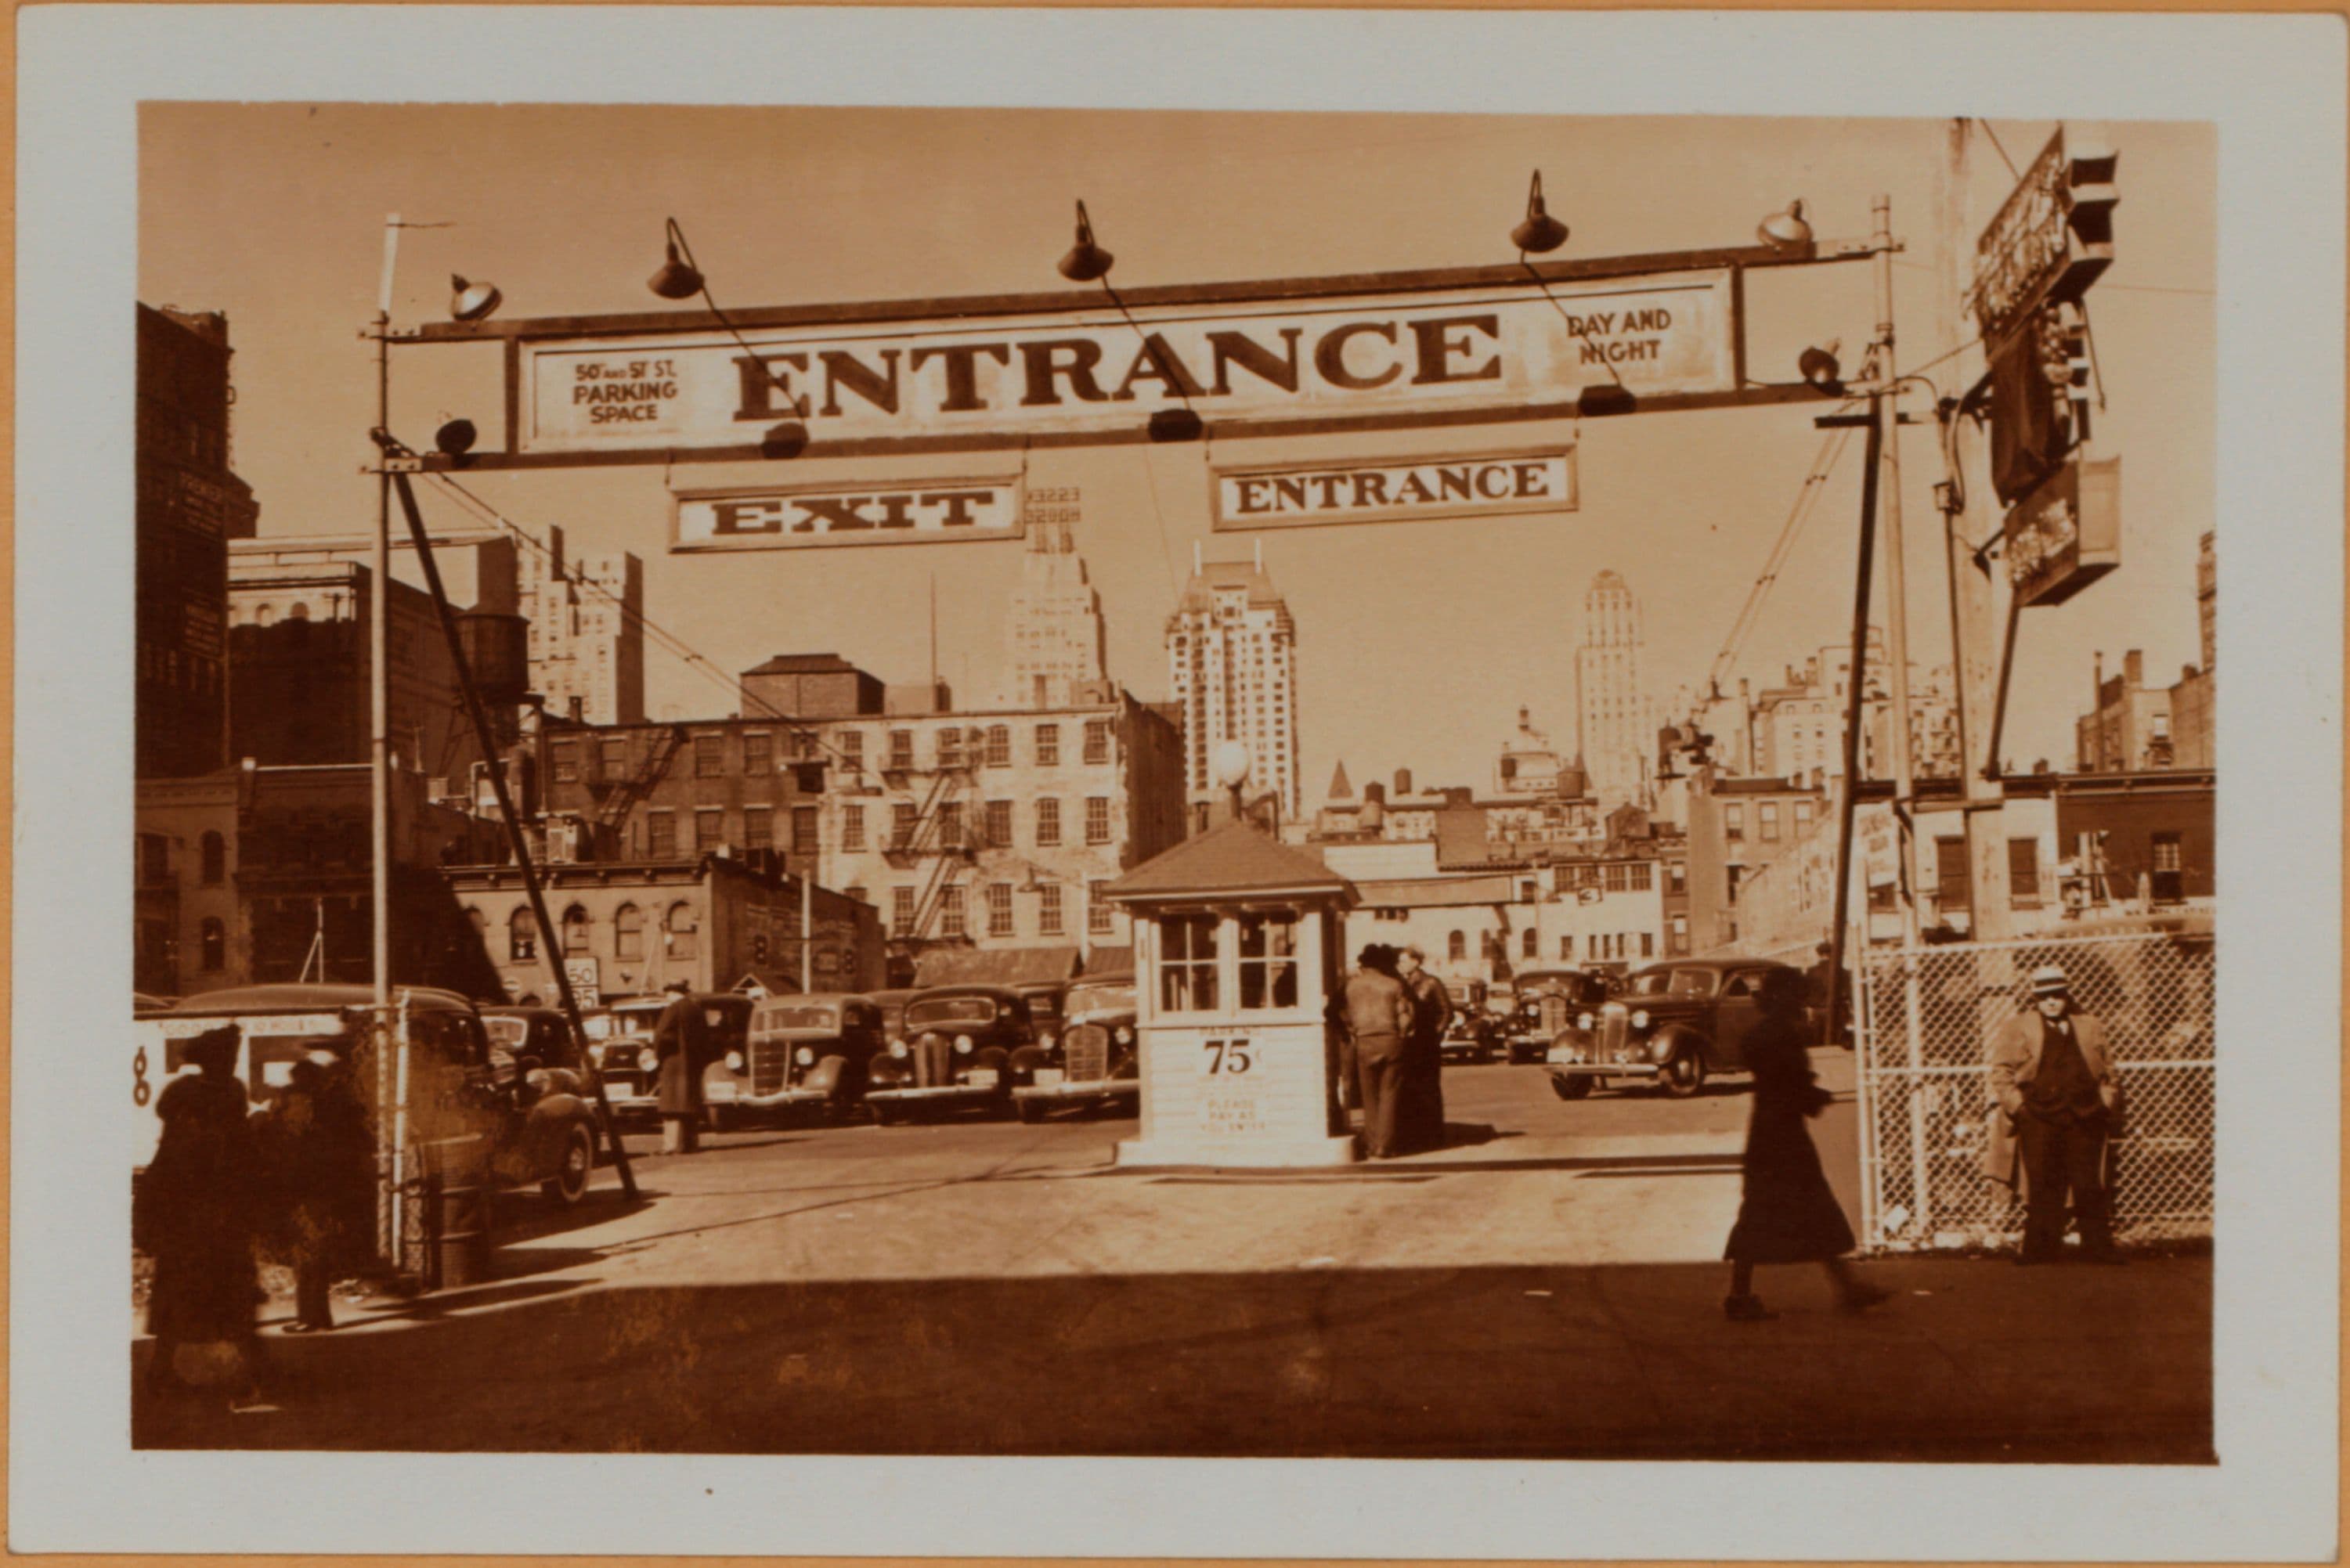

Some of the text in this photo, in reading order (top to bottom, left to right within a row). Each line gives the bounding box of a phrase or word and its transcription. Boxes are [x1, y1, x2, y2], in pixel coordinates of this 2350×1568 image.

[1568, 308, 1671, 337] DAY AND
[1579, 339, 1660, 364] NIGHT
[731, 315, 1502, 422] ENTRANCE
[573, 381, 677, 405] PARKING
[590, 404, 658, 424] SPACE
[1235, 462, 1550, 514] ENTRANCE
[711, 490, 995, 535] EXIT
